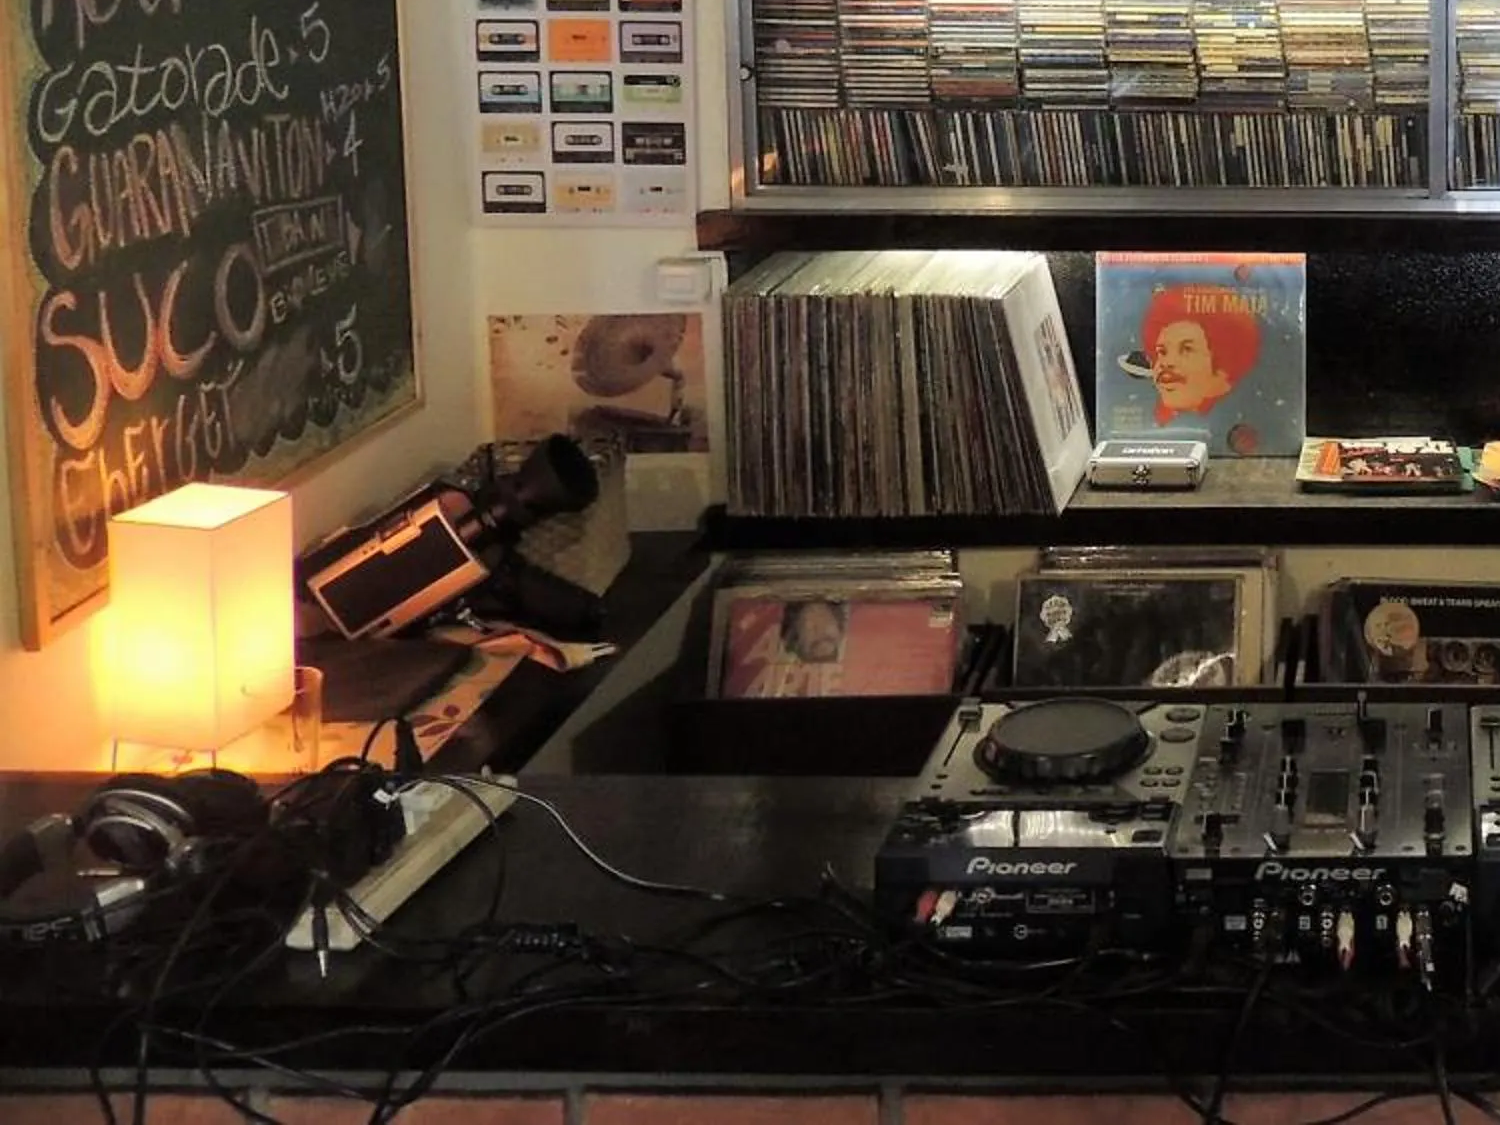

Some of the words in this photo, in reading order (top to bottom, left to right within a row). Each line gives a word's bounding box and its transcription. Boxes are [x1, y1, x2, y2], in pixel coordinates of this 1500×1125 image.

[301, 2, 330, 64] 5
[343, 113, 364, 176] 4
[1184, 293, 1218, 315] TIM
[44, 243, 266, 449] SUCO
[333, 304, 362, 385] 5
[967, 857, 1078, 876] Pioneer
[1255, 861, 1386, 880] Pioneer
